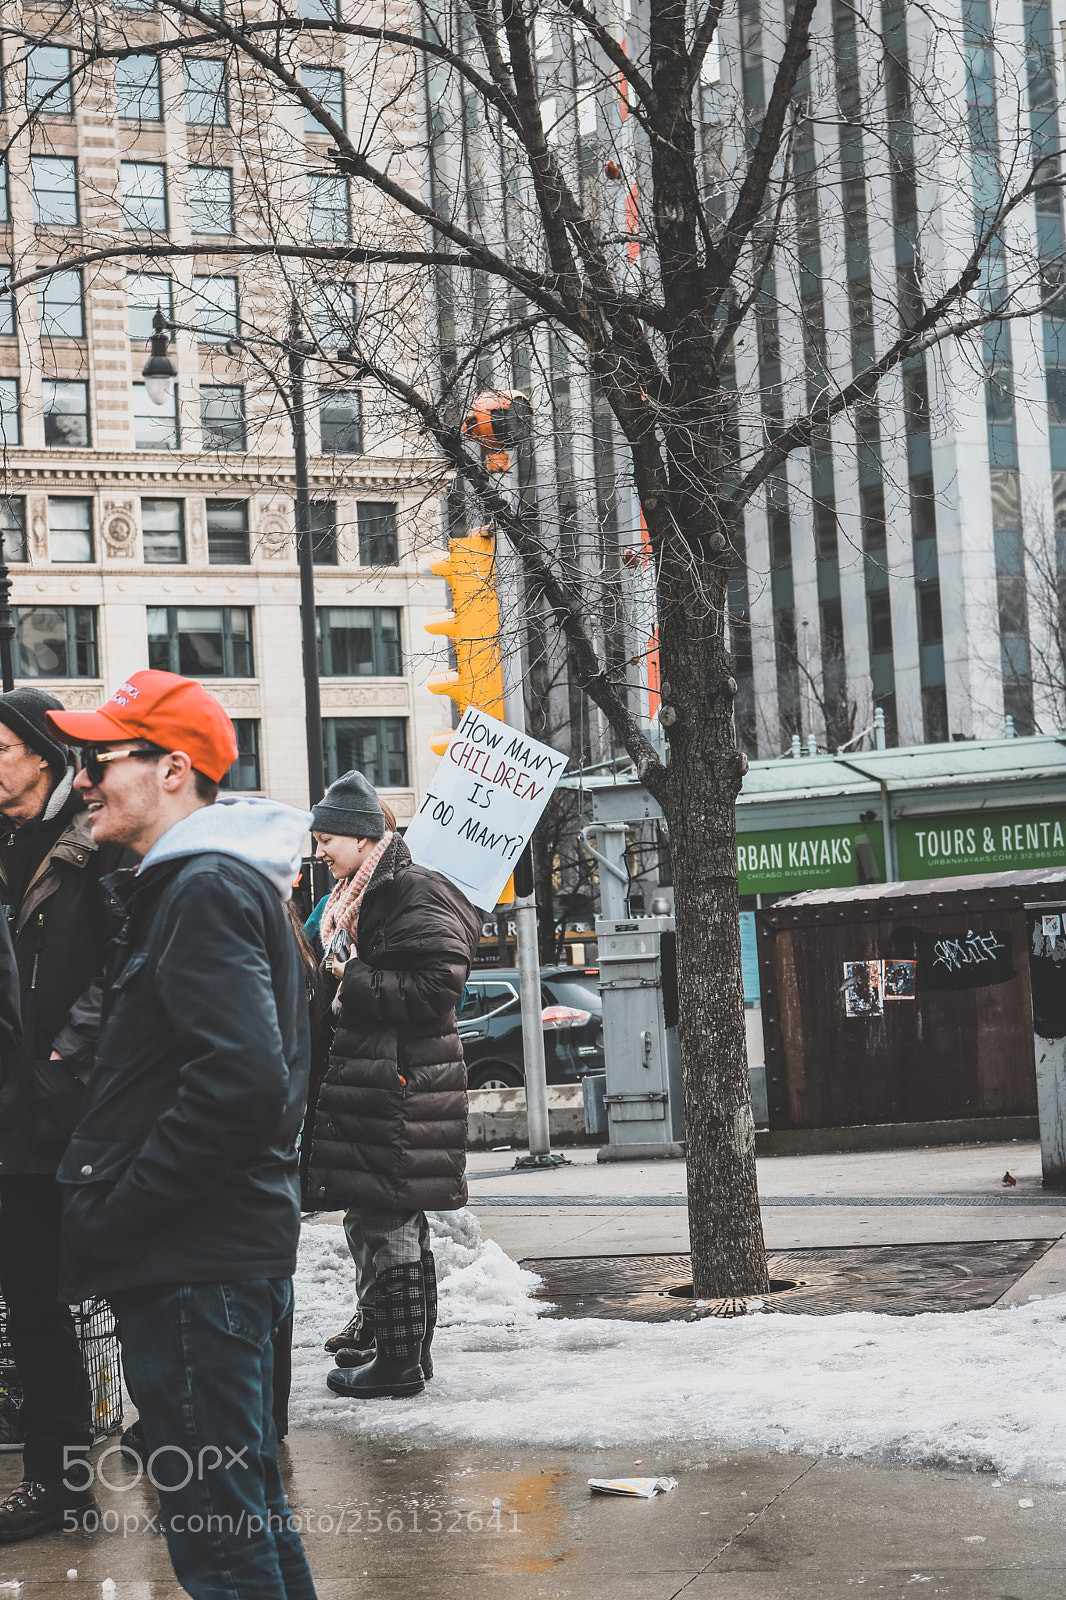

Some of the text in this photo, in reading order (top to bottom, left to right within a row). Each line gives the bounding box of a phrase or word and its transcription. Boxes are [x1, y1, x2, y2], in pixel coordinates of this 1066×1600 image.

[459, 710, 562, 778] HOW MANY
[449, 741, 544, 800] CHILDREN
[419, 792, 455, 826] TOO
[467, 782, 494, 808] IS
[457, 817, 524, 860] MANY?
[788, 837, 852, 868] KAYAKS
[914, 827, 976, 858] TOURS
[982, 826, 996, 853] &
[746, 868, 831, 880] CHICAGO RIVERWALK
